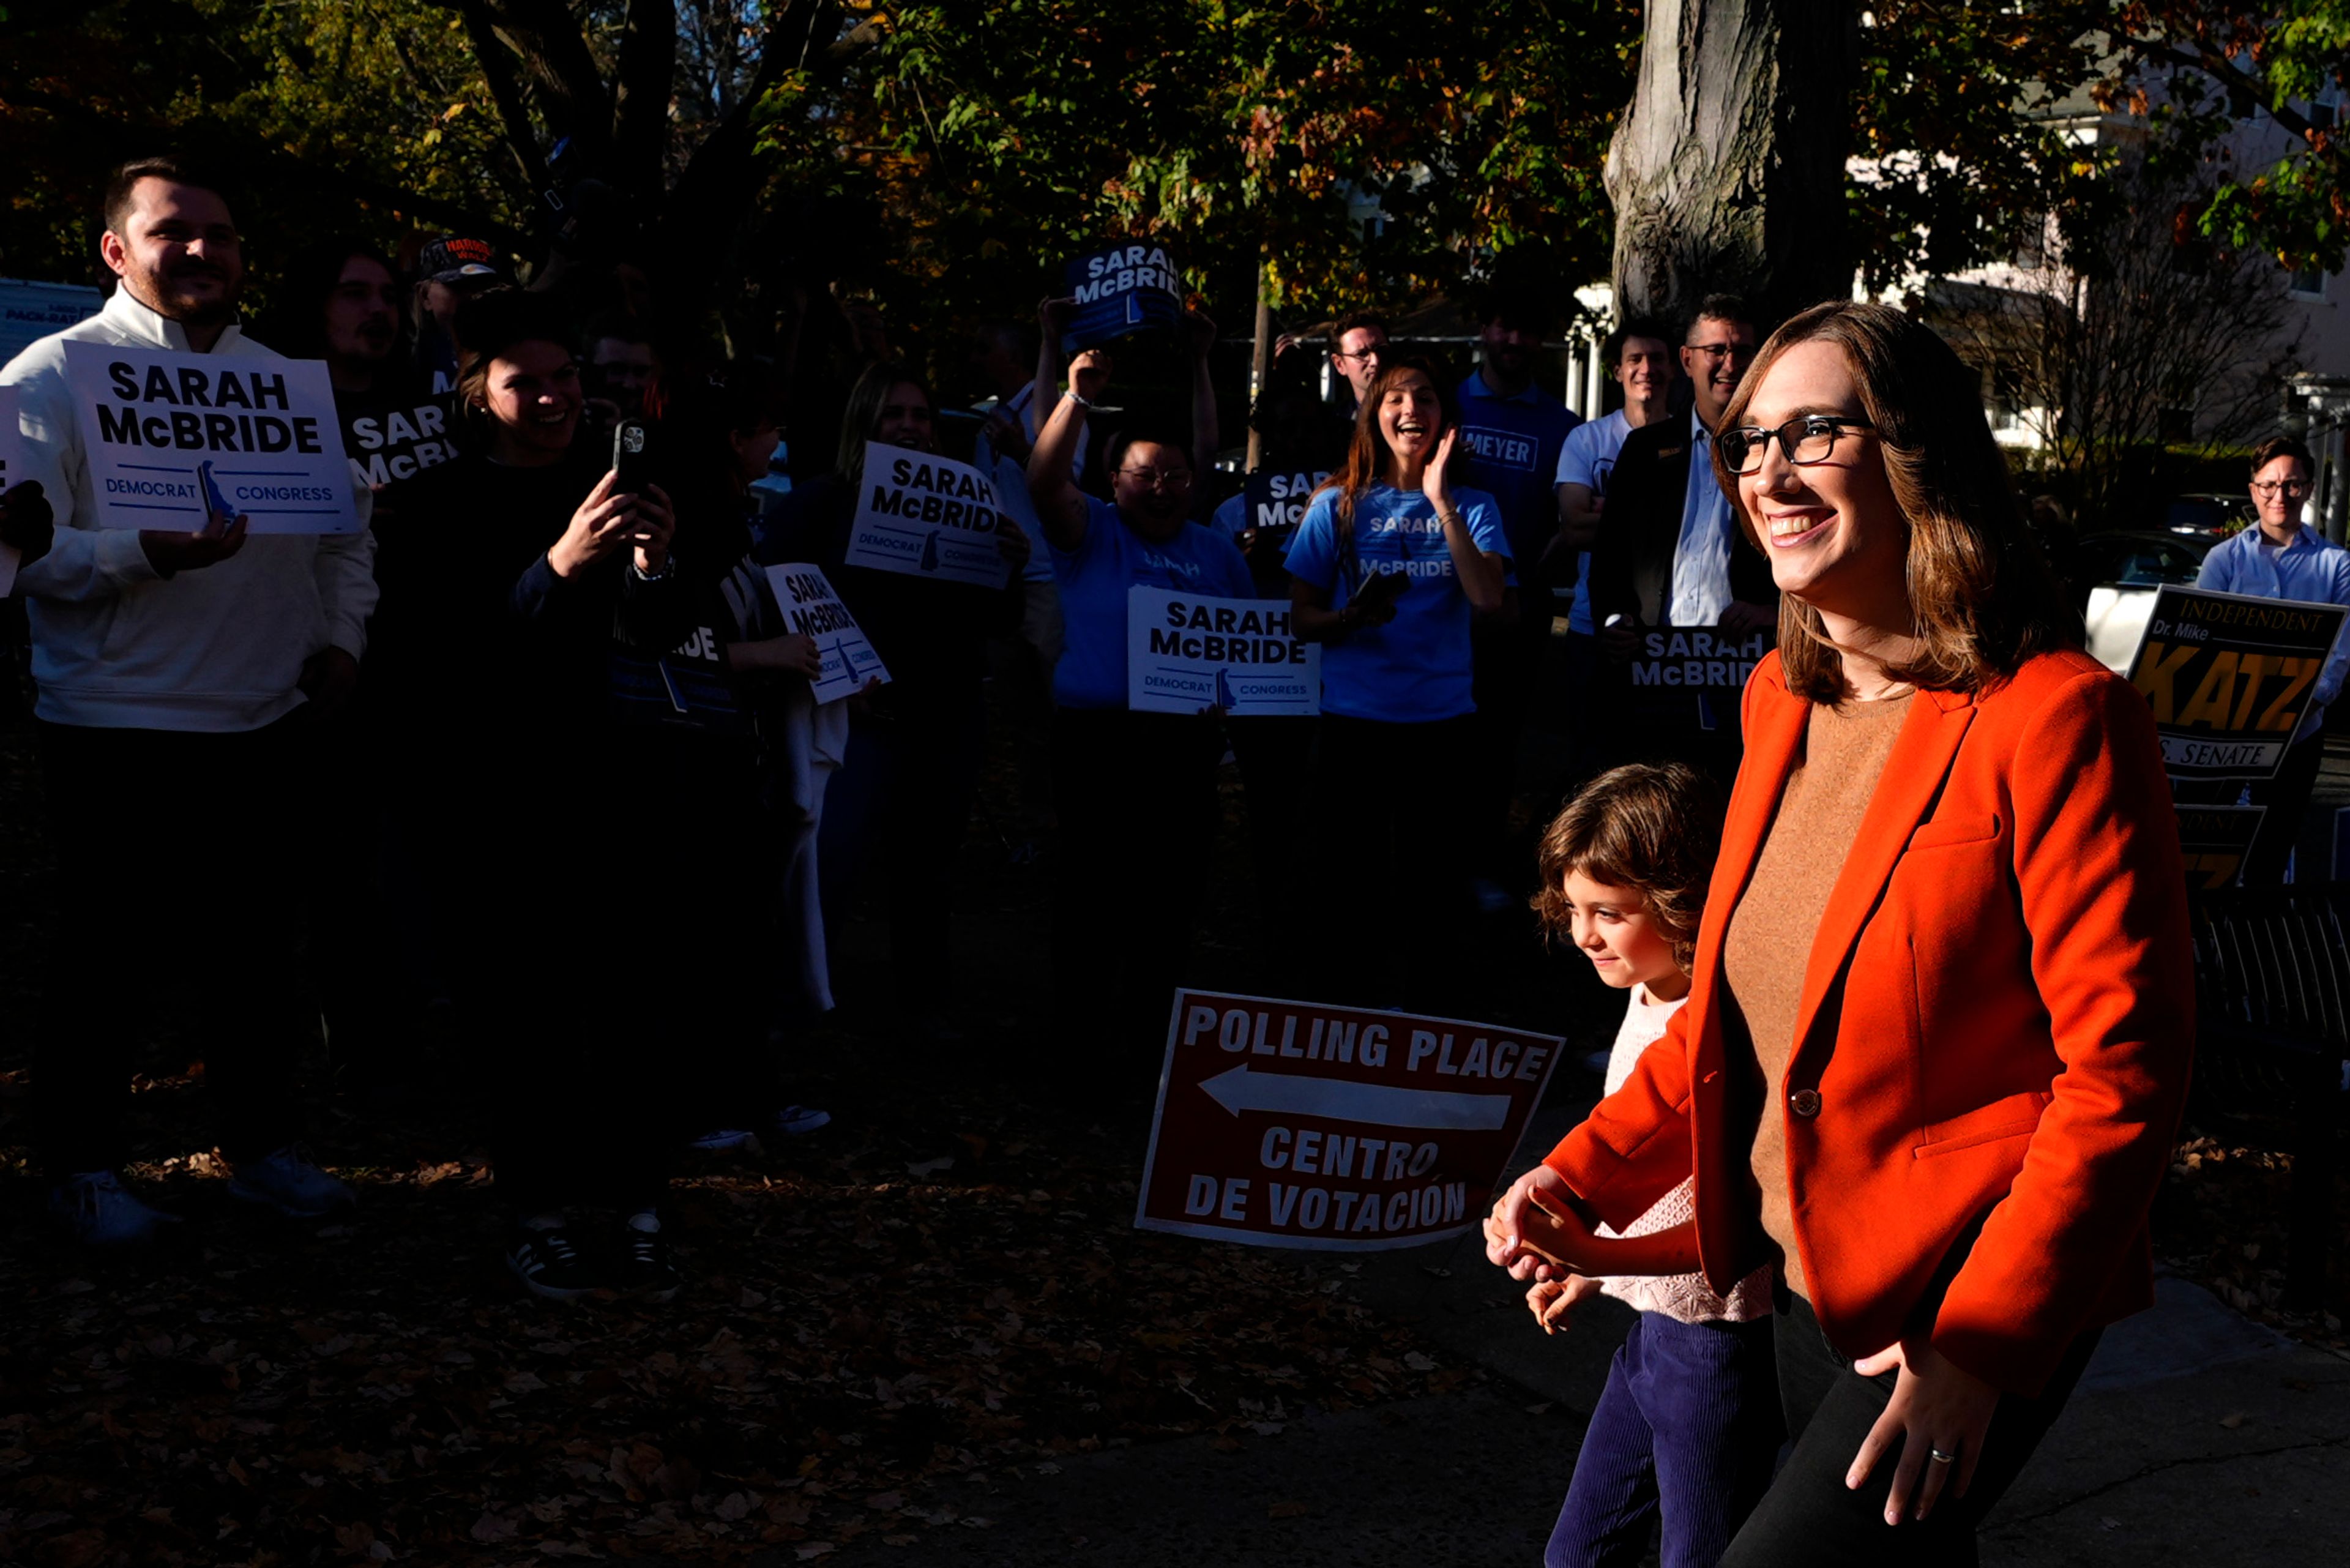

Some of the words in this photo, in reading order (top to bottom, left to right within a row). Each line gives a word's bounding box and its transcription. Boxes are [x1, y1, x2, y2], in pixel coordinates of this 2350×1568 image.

[108, 362, 289, 410] SARAH
[96, 403, 323, 454] McBRIDE
[1466, 432, 1530, 463] MEYER
[106, 479, 196, 498] DEMOCRAT
[236, 487, 333, 501] CONGRESS
[892, 459, 994, 506] SARAH
[1370, 517, 1442, 534] SARAH
[859, 533, 922, 554] DEMOCRAT
[1167, 602, 1289, 635] SARAH
[2152, 619, 2172, 636] Dr.
[2174, 622, 2210, 641] Mike
[2179, 599, 2324, 633] INDEPENDENT
[1150, 628, 1306, 663] McBRIDE
[1644, 632, 1763, 659] SARAH
[1145, 676, 1212, 693] DEMOCRAT
[1240, 685, 1307, 695] CONGRESS
[2131, 641, 2322, 732] KATZ
[2181, 744, 2265, 765] SENATE
[1183, 1005, 1389, 1068] POLLING
[1406, 1029, 1548, 1082] PLACE
[1259, 1126, 1439, 1182] CENTRO
[1184, 1174, 1251, 1222] DE
[1269, 1173, 1466, 1233] VOTACIÓN
